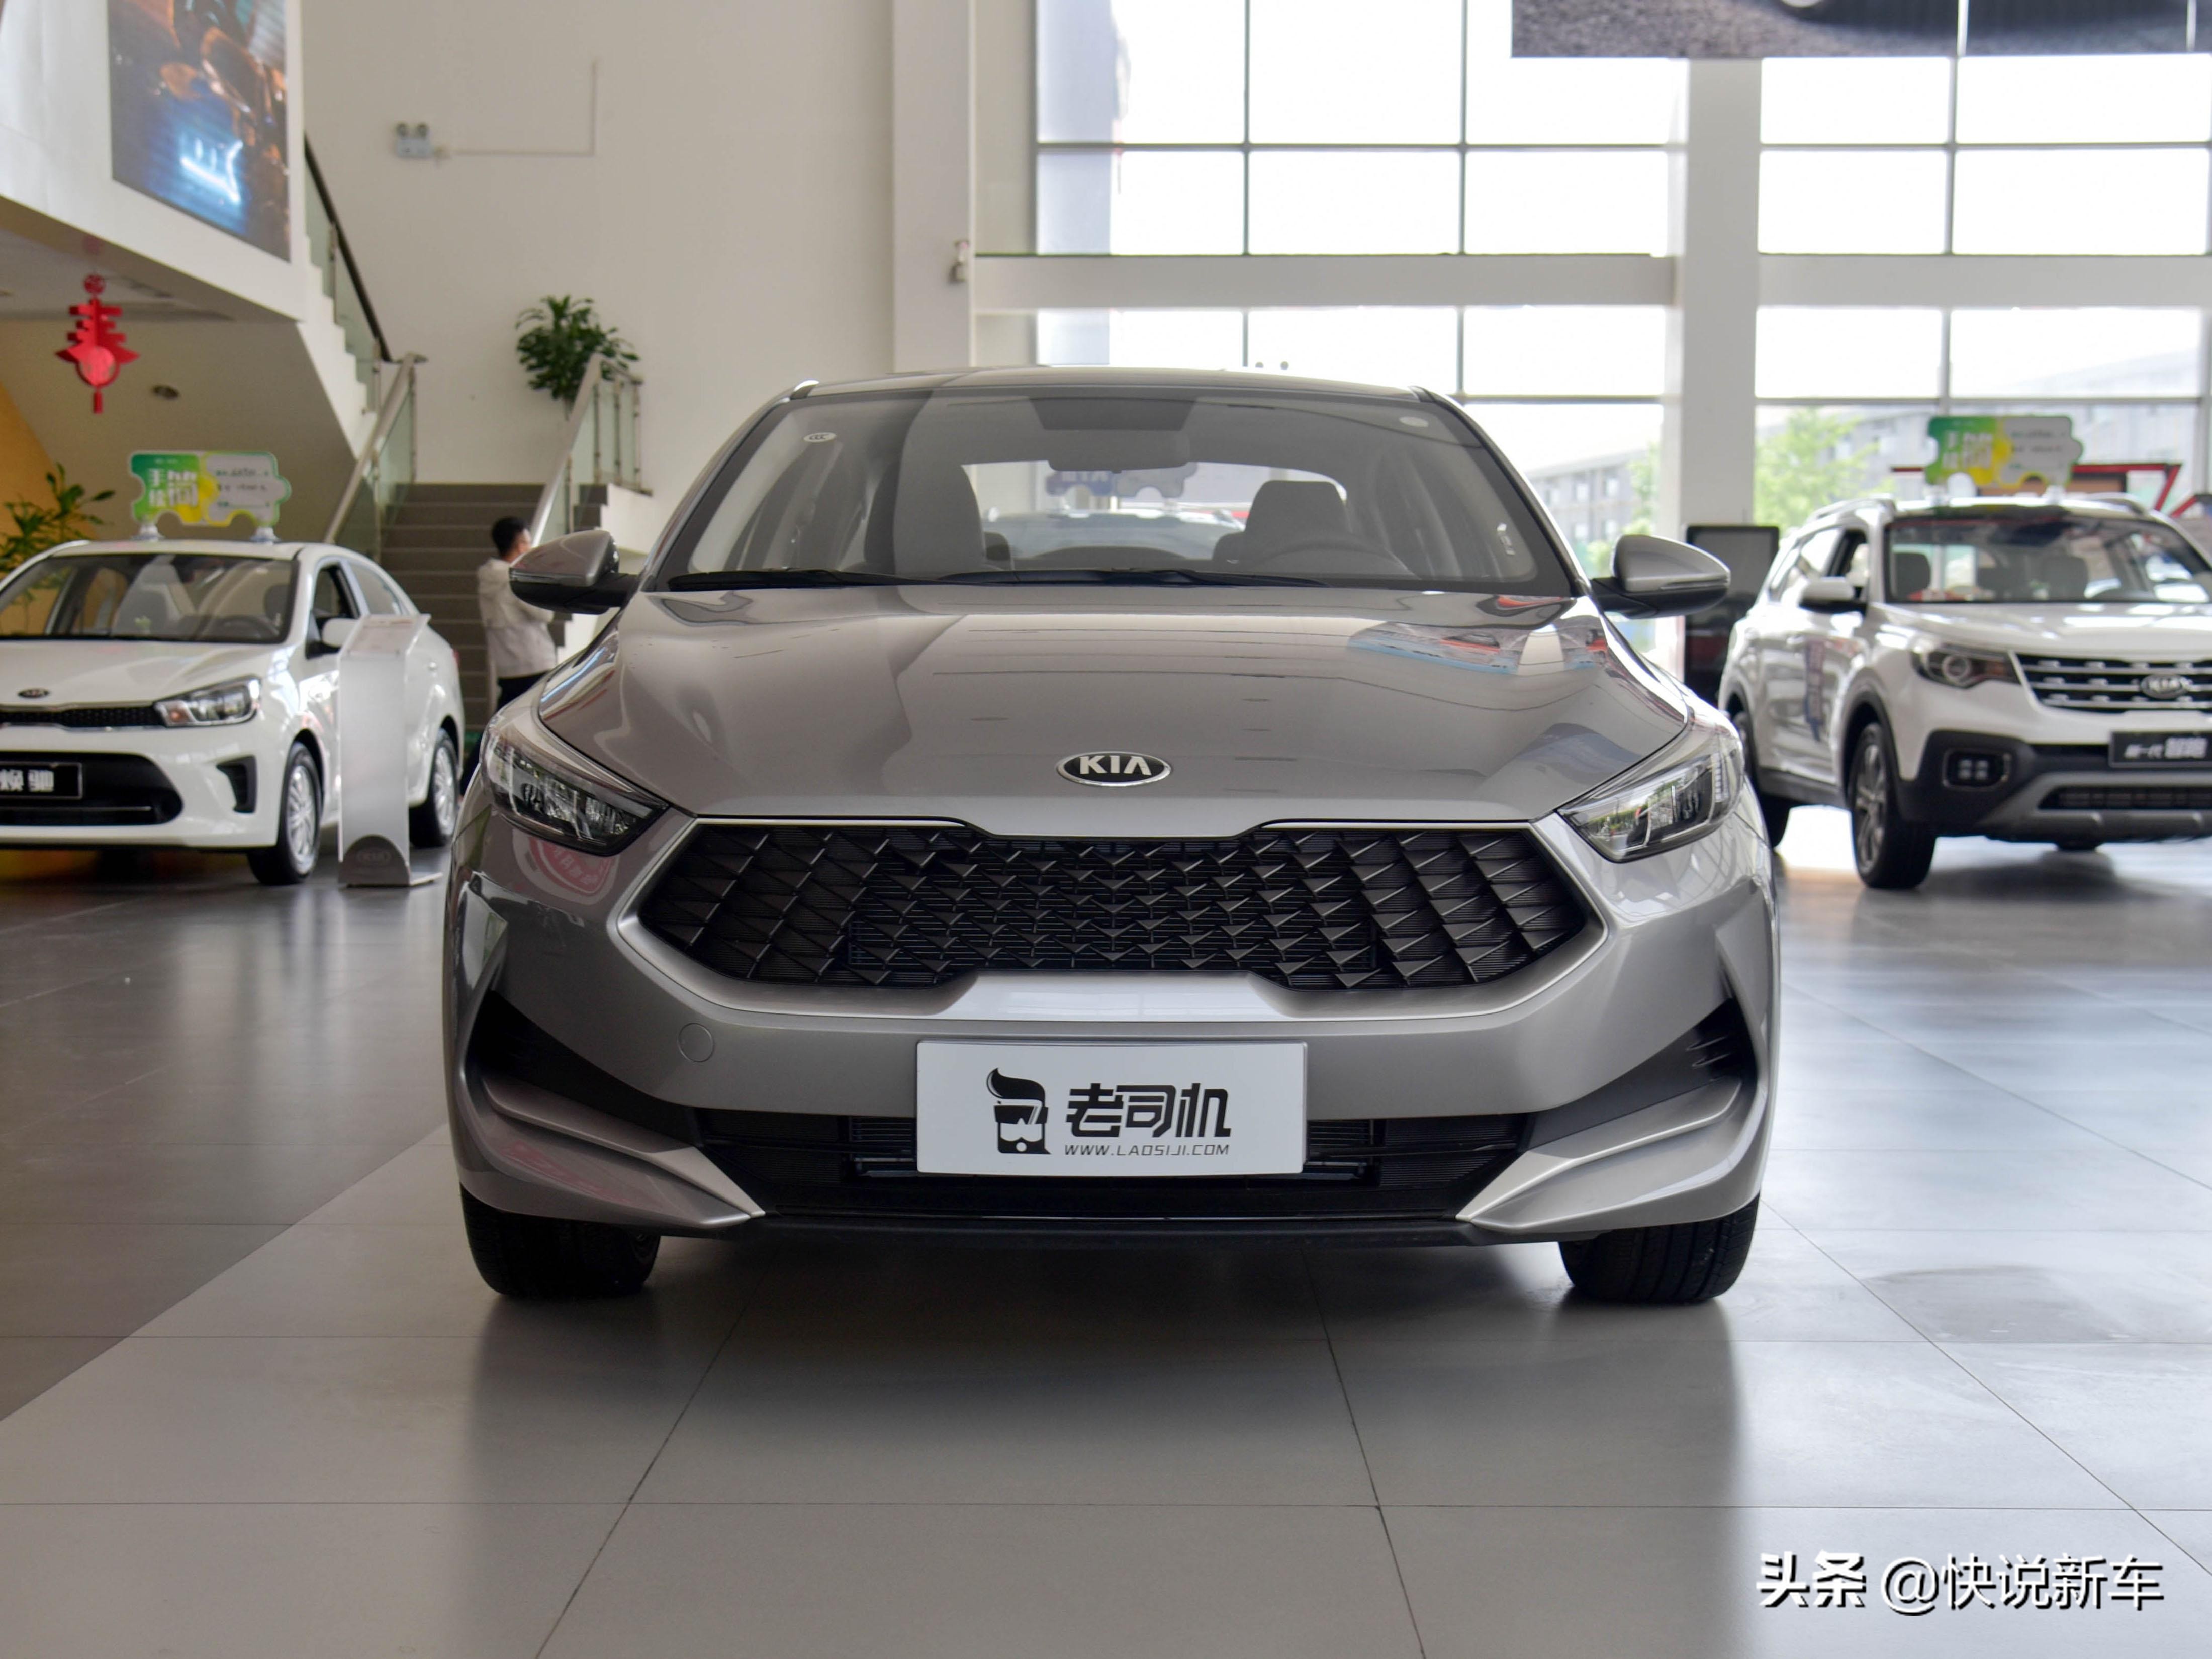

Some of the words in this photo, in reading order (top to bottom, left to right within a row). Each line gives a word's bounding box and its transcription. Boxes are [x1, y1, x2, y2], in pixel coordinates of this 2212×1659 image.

[1079, 755, 1152, 775] KIA
[1065, 1082, 1231, 1138] 老司机
[1064, 1144, 1229, 1156] WWW.LAOSIJI.COM
